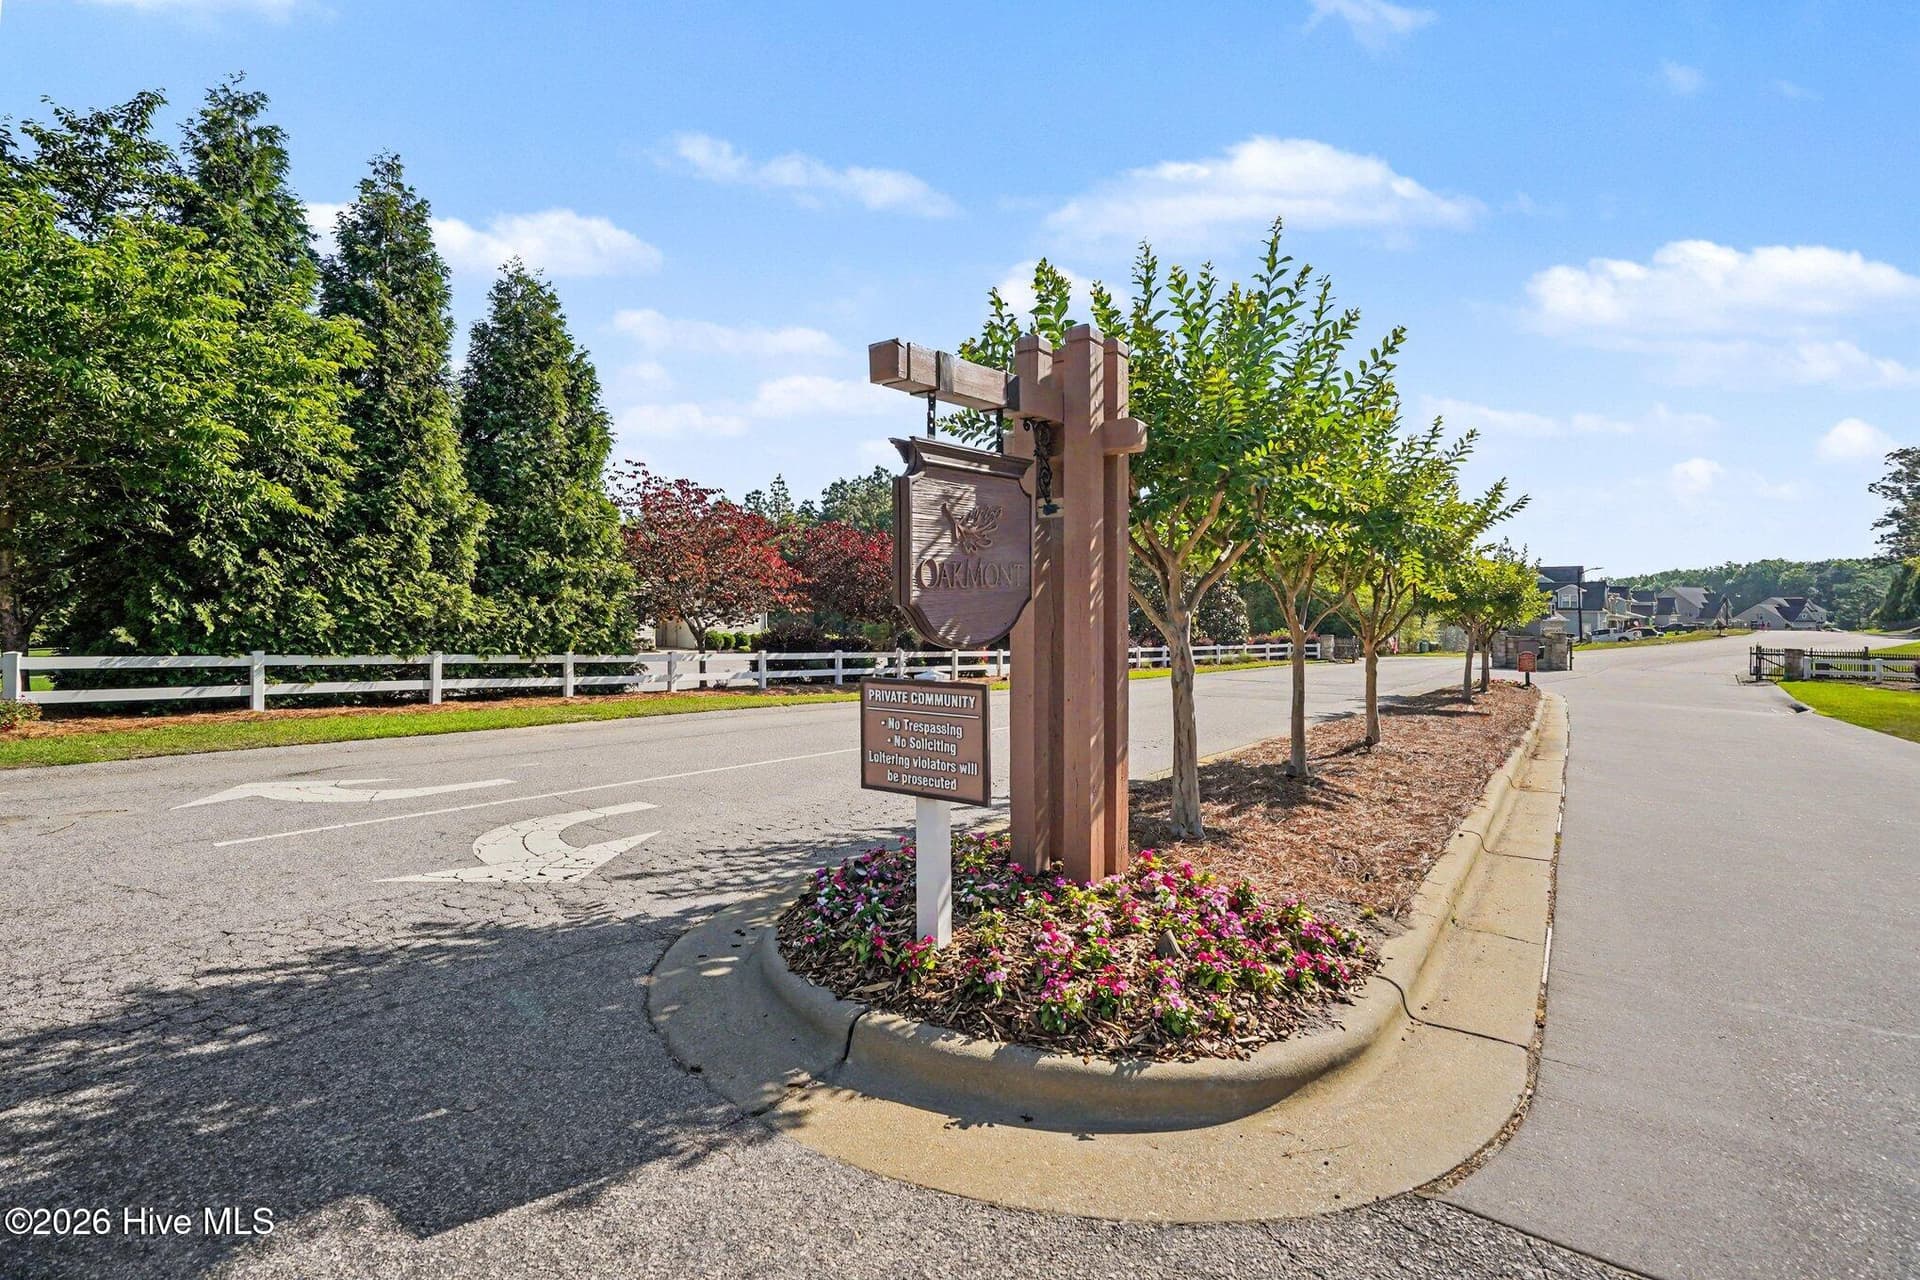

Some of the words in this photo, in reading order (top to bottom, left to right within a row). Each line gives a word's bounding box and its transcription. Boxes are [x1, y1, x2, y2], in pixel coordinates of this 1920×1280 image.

[918, 558, 1023, 590] OAKMONT
[868, 689, 908, 703] PRIVATE
[911, 692, 976, 709] COMMUNITY
[888, 717, 900, 730] No
[904, 719, 963, 739] Trespassing
[894, 735, 907, 748] No
[909, 737, 957, 756] Soliciting
[868, 750, 910, 769] Loitering
[912, 757, 957, 773] violators
[959, 762, 978, 776] will
[887, 769, 899, 782] be
[901, 773, 957, 791] prosecuted
